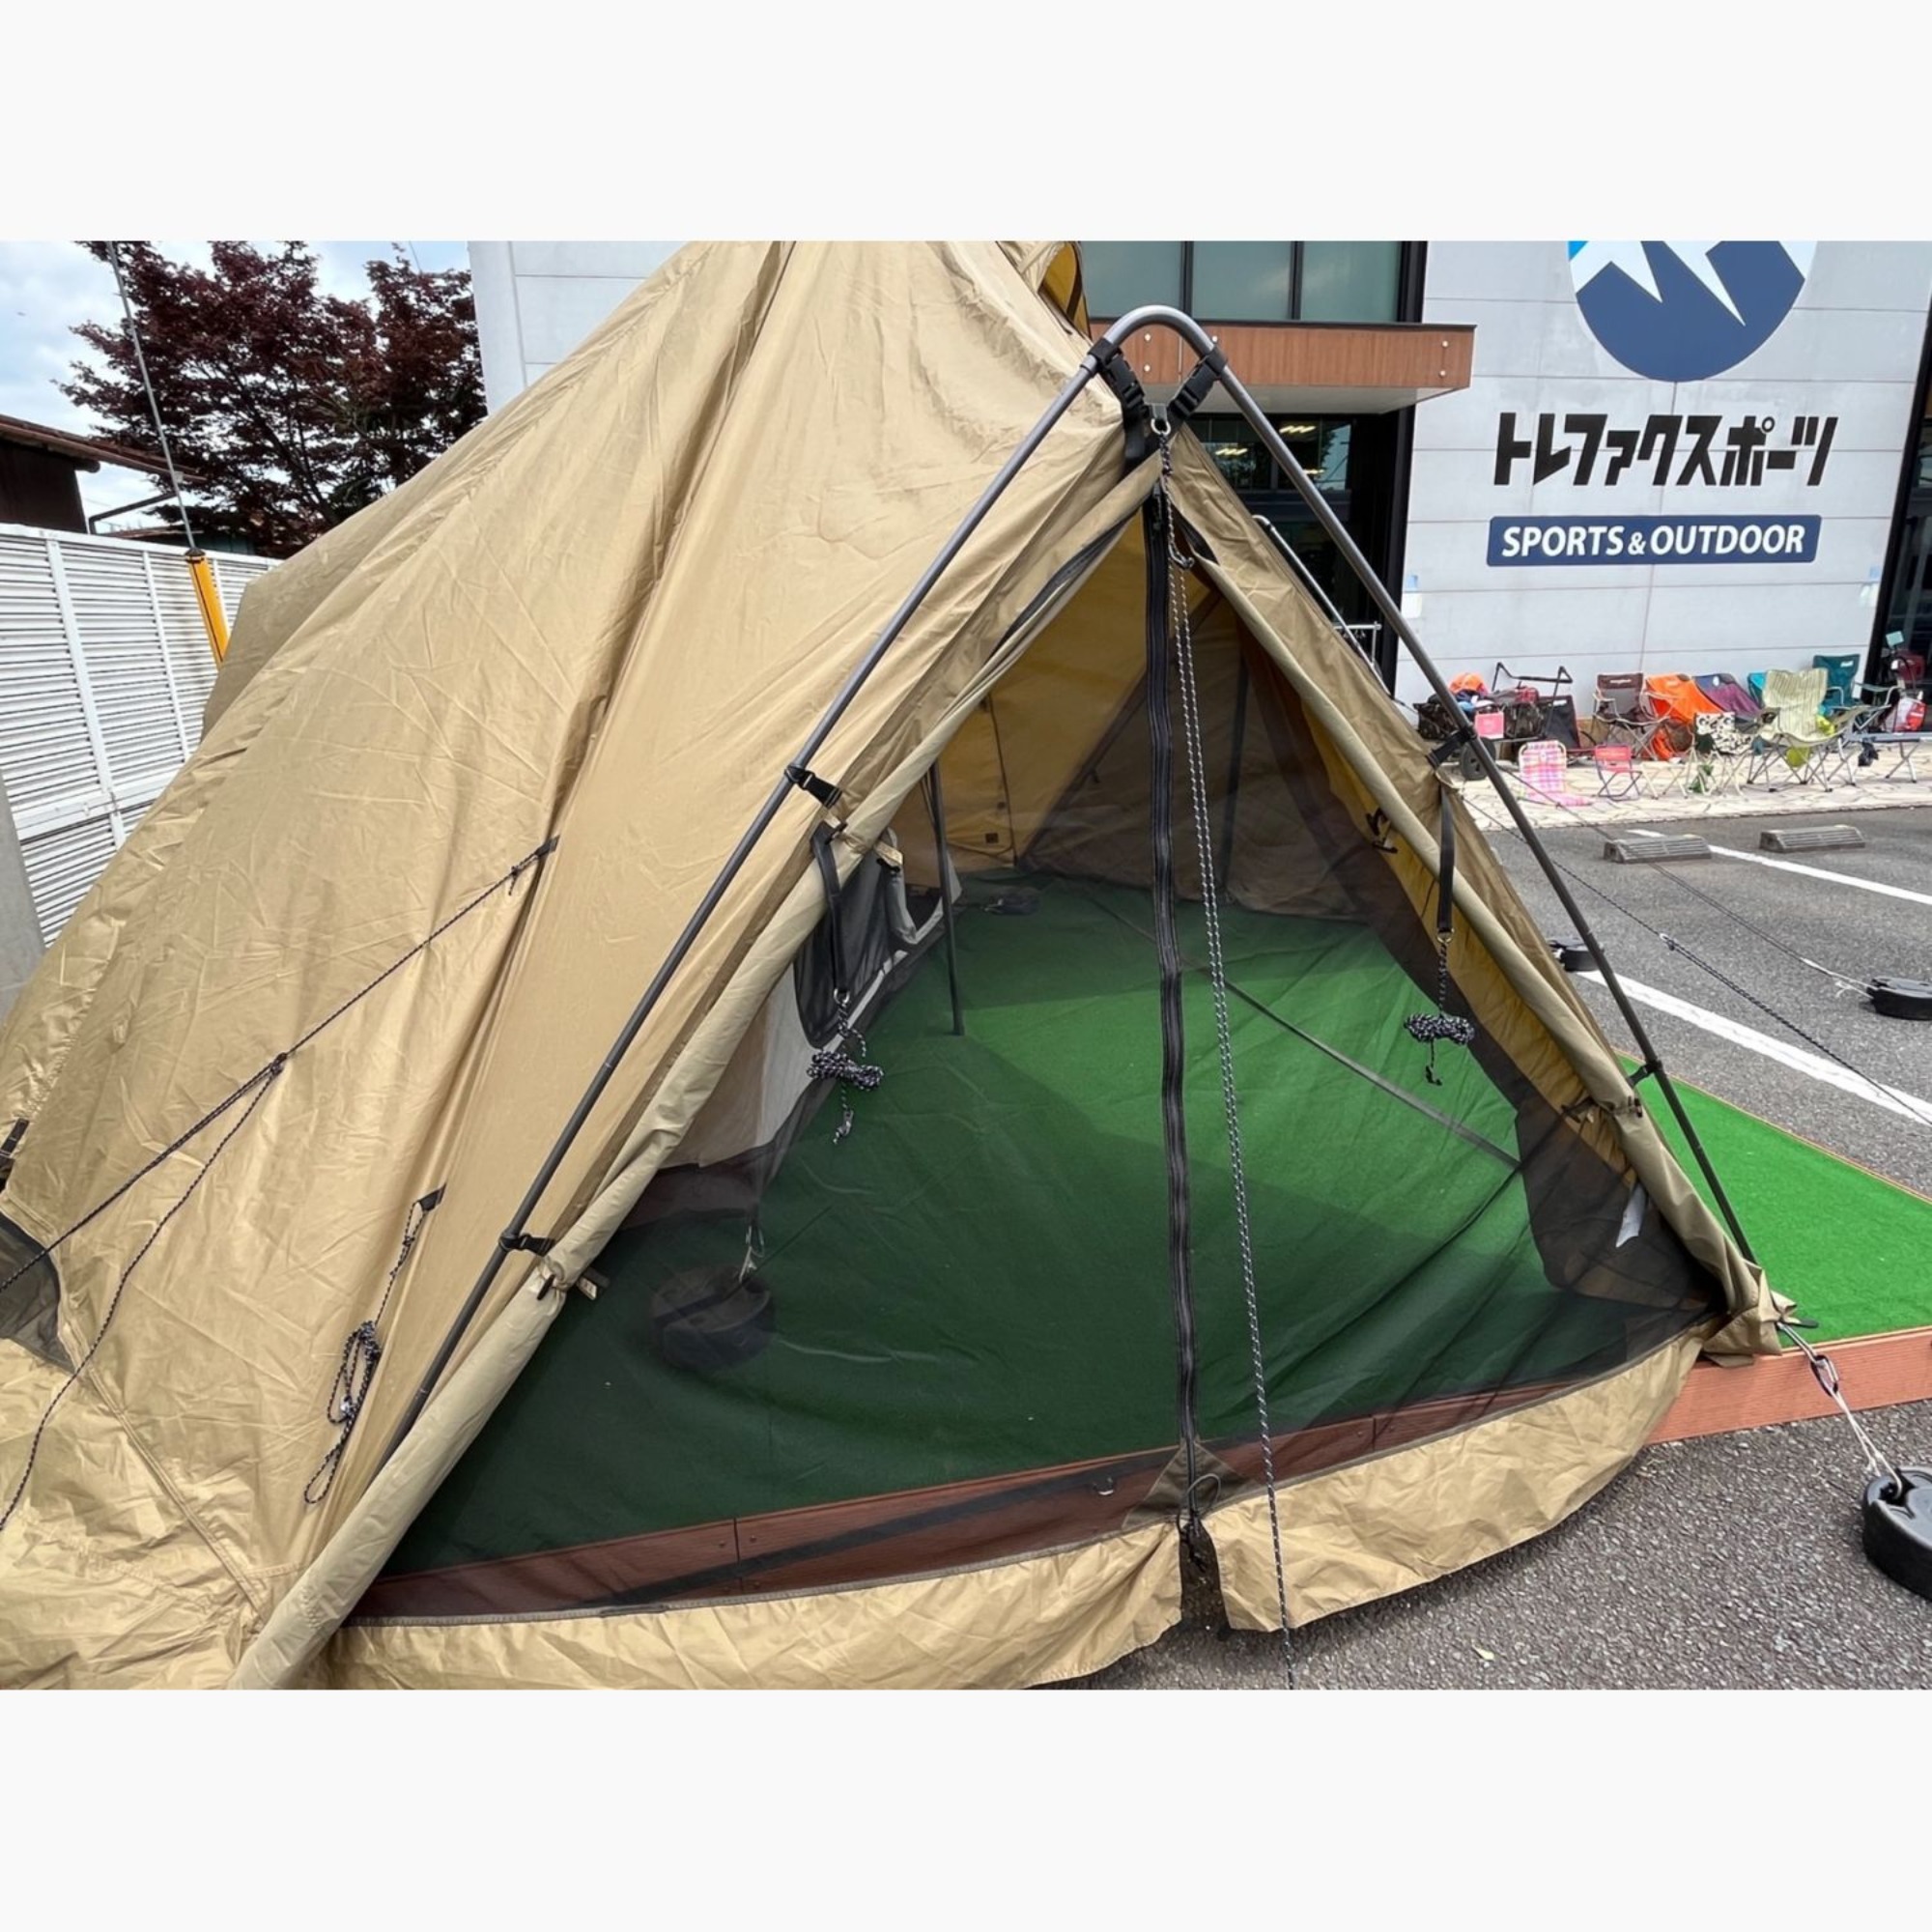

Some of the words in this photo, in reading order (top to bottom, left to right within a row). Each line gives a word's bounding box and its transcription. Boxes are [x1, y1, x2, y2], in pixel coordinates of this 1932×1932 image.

[1493, 412, 1838, 487] トレファクスポーツ
[1501, 525, 1625, 557] SPORTS
[1649, 524, 1805, 555] OUTDOOR
